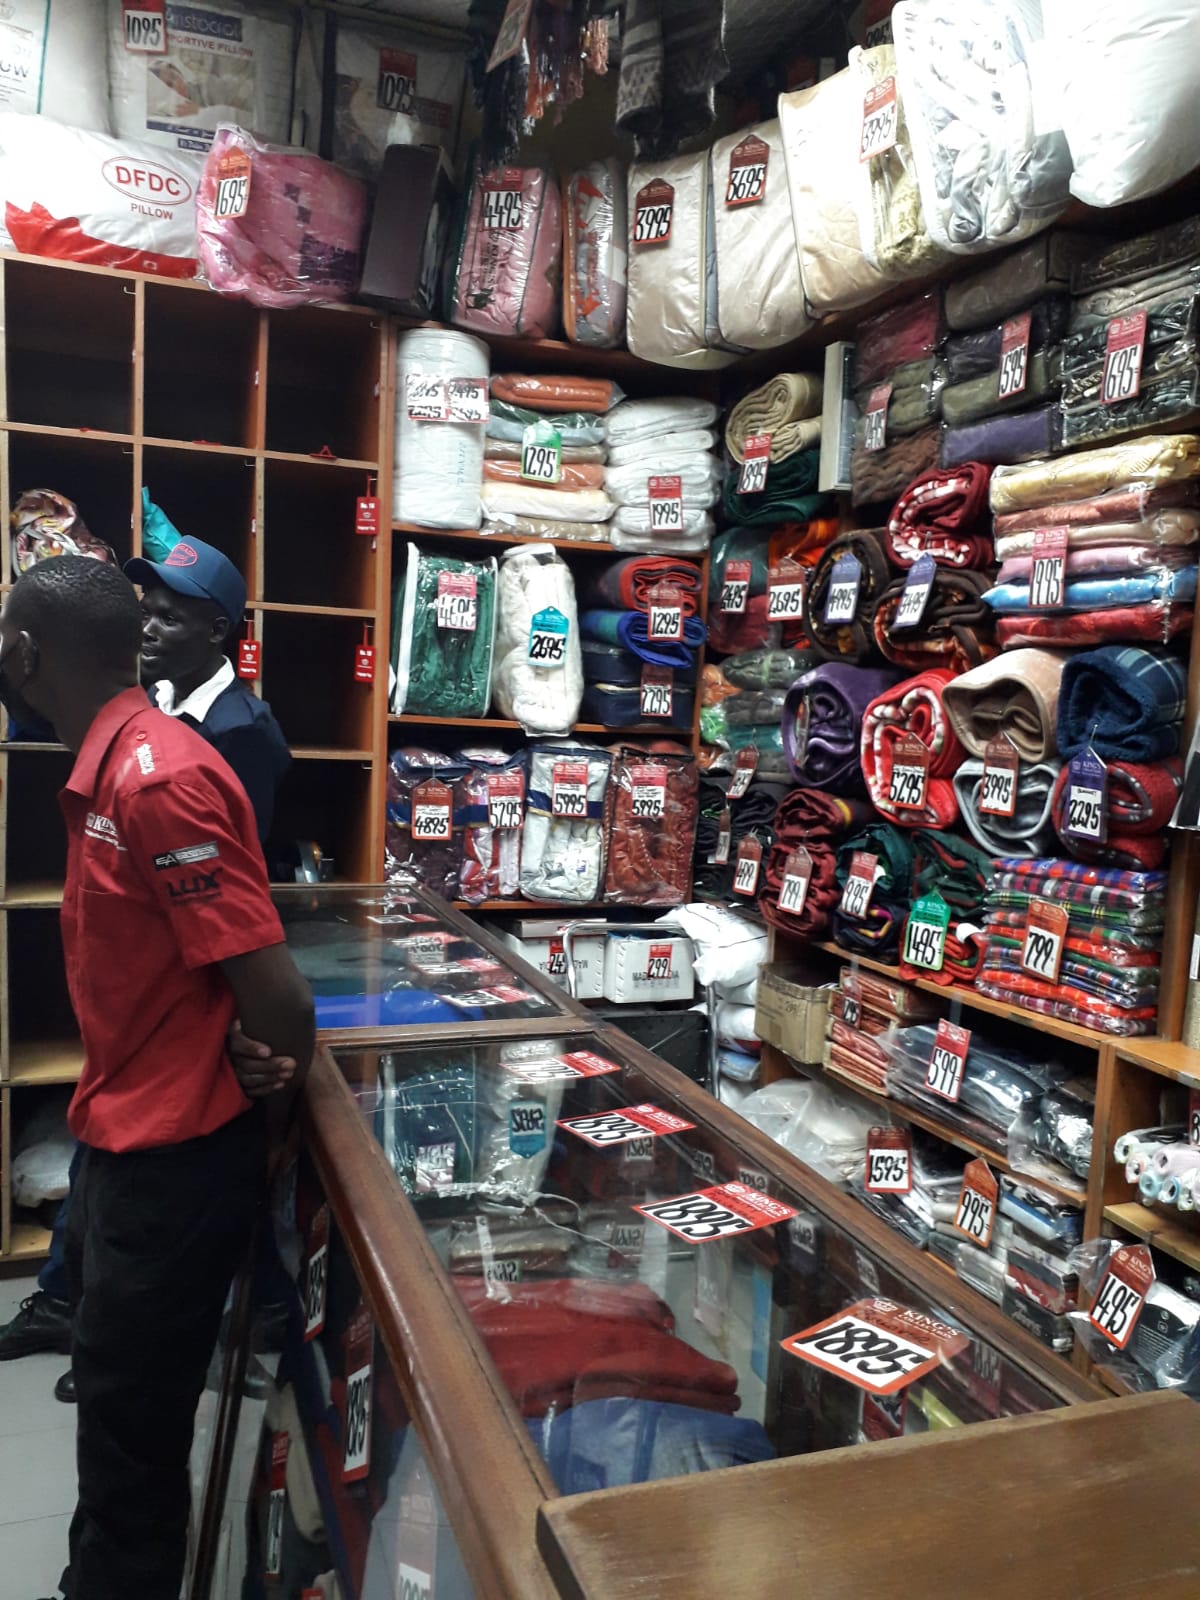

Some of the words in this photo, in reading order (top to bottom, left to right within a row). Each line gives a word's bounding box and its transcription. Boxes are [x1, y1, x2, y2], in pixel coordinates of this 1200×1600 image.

[126, 14, 162, 47] 1095
[115, 166, 181, 196] DFDC
[726, 167, 766, 201] 3695
[130, 203, 173, 220] PILLOW
[215, 179, 247, 216] 1695
[484, 192, 522, 228] 4495
[634, 208, 671, 241] 3995
[523, 446, 556, 478] 1295
[652, 503, 680, 526] 1995
[1030, 559, 1062, 605] 1995
[651, 612, 680, 635] 1295
[888, 771, 924, 804] 5295
[983, 773, 1012, 804] 3995
[491, 802, 521, 829] 5295
[554, 793, 586, 813] 5995
[1070, 799, 1102, 829] 2295
[415, 816, 449, 834] 4895
[648, 958, 668, 979] 299
[560, 1112, 652, 1141] 1895
[641, 1195, 753, 1238] 1895
[748, 1192, 791, 1215] KING'S
[903, 1310, 959, 1337] KING'S
